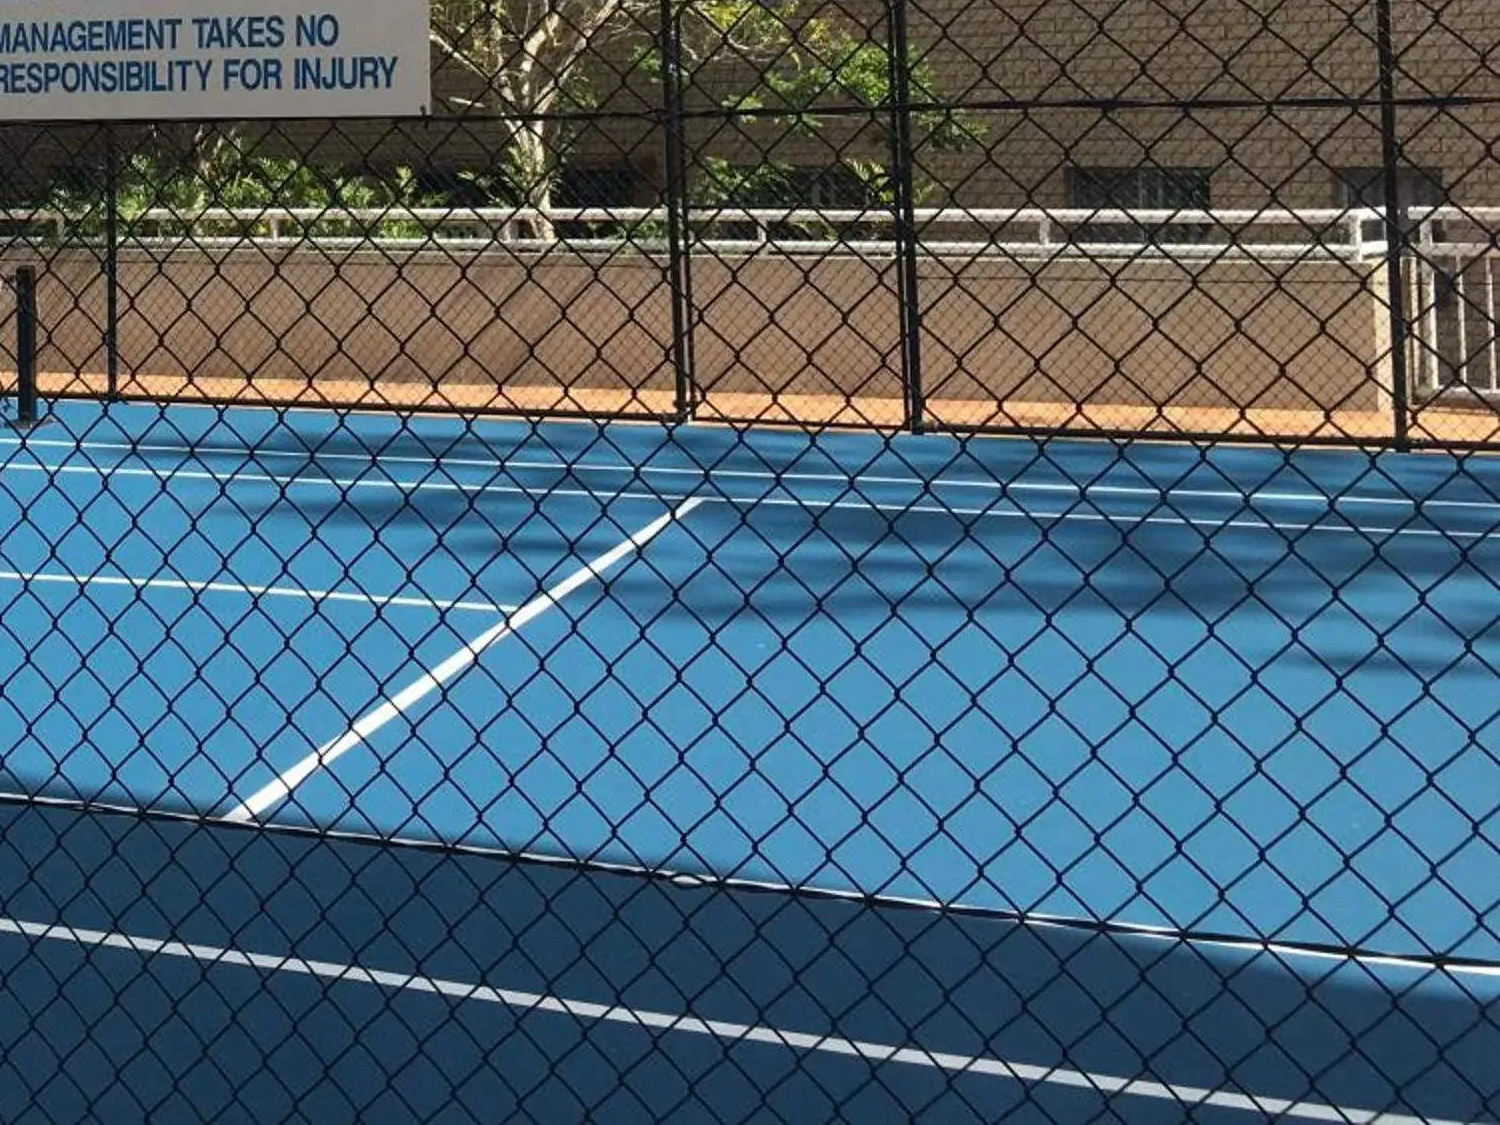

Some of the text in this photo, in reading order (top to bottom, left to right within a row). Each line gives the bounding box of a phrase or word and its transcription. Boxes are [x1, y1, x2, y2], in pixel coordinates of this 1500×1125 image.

[192, 14, 284, 49] TAKES
[295, 14, 339, 47] NO
[223, 58, 282, 92] FOR
[294, 56, 398, 91] INJURY
